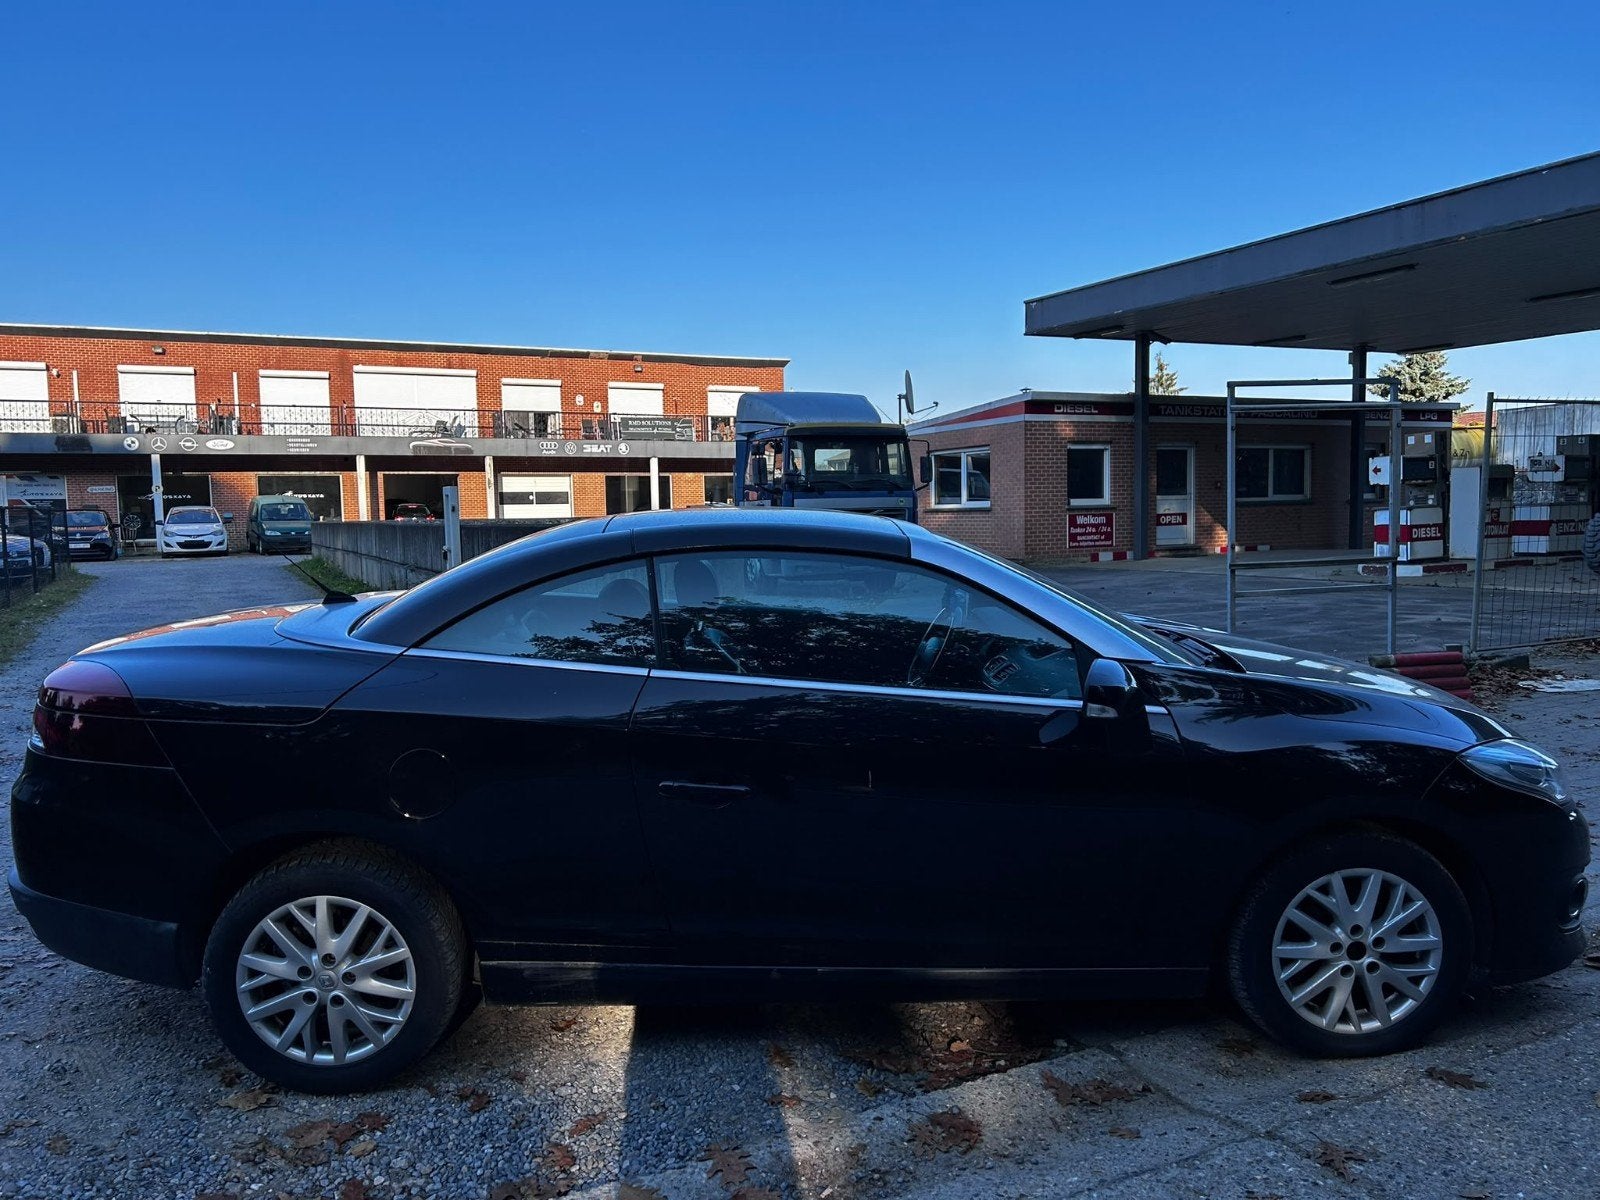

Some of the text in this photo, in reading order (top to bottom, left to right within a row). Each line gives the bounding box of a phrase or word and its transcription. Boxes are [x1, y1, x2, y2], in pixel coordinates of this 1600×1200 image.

[1054, 403, 1099, 414] DIESEL
[1419, 411, 1438, 421] LPG
[582, 444, 612, 453] SEAT
[1076, 514, 1106, 525] Welkom
[1159, 515, 1183, 524] OPEN
[1412, 526, 1442, 539] DIESEL
